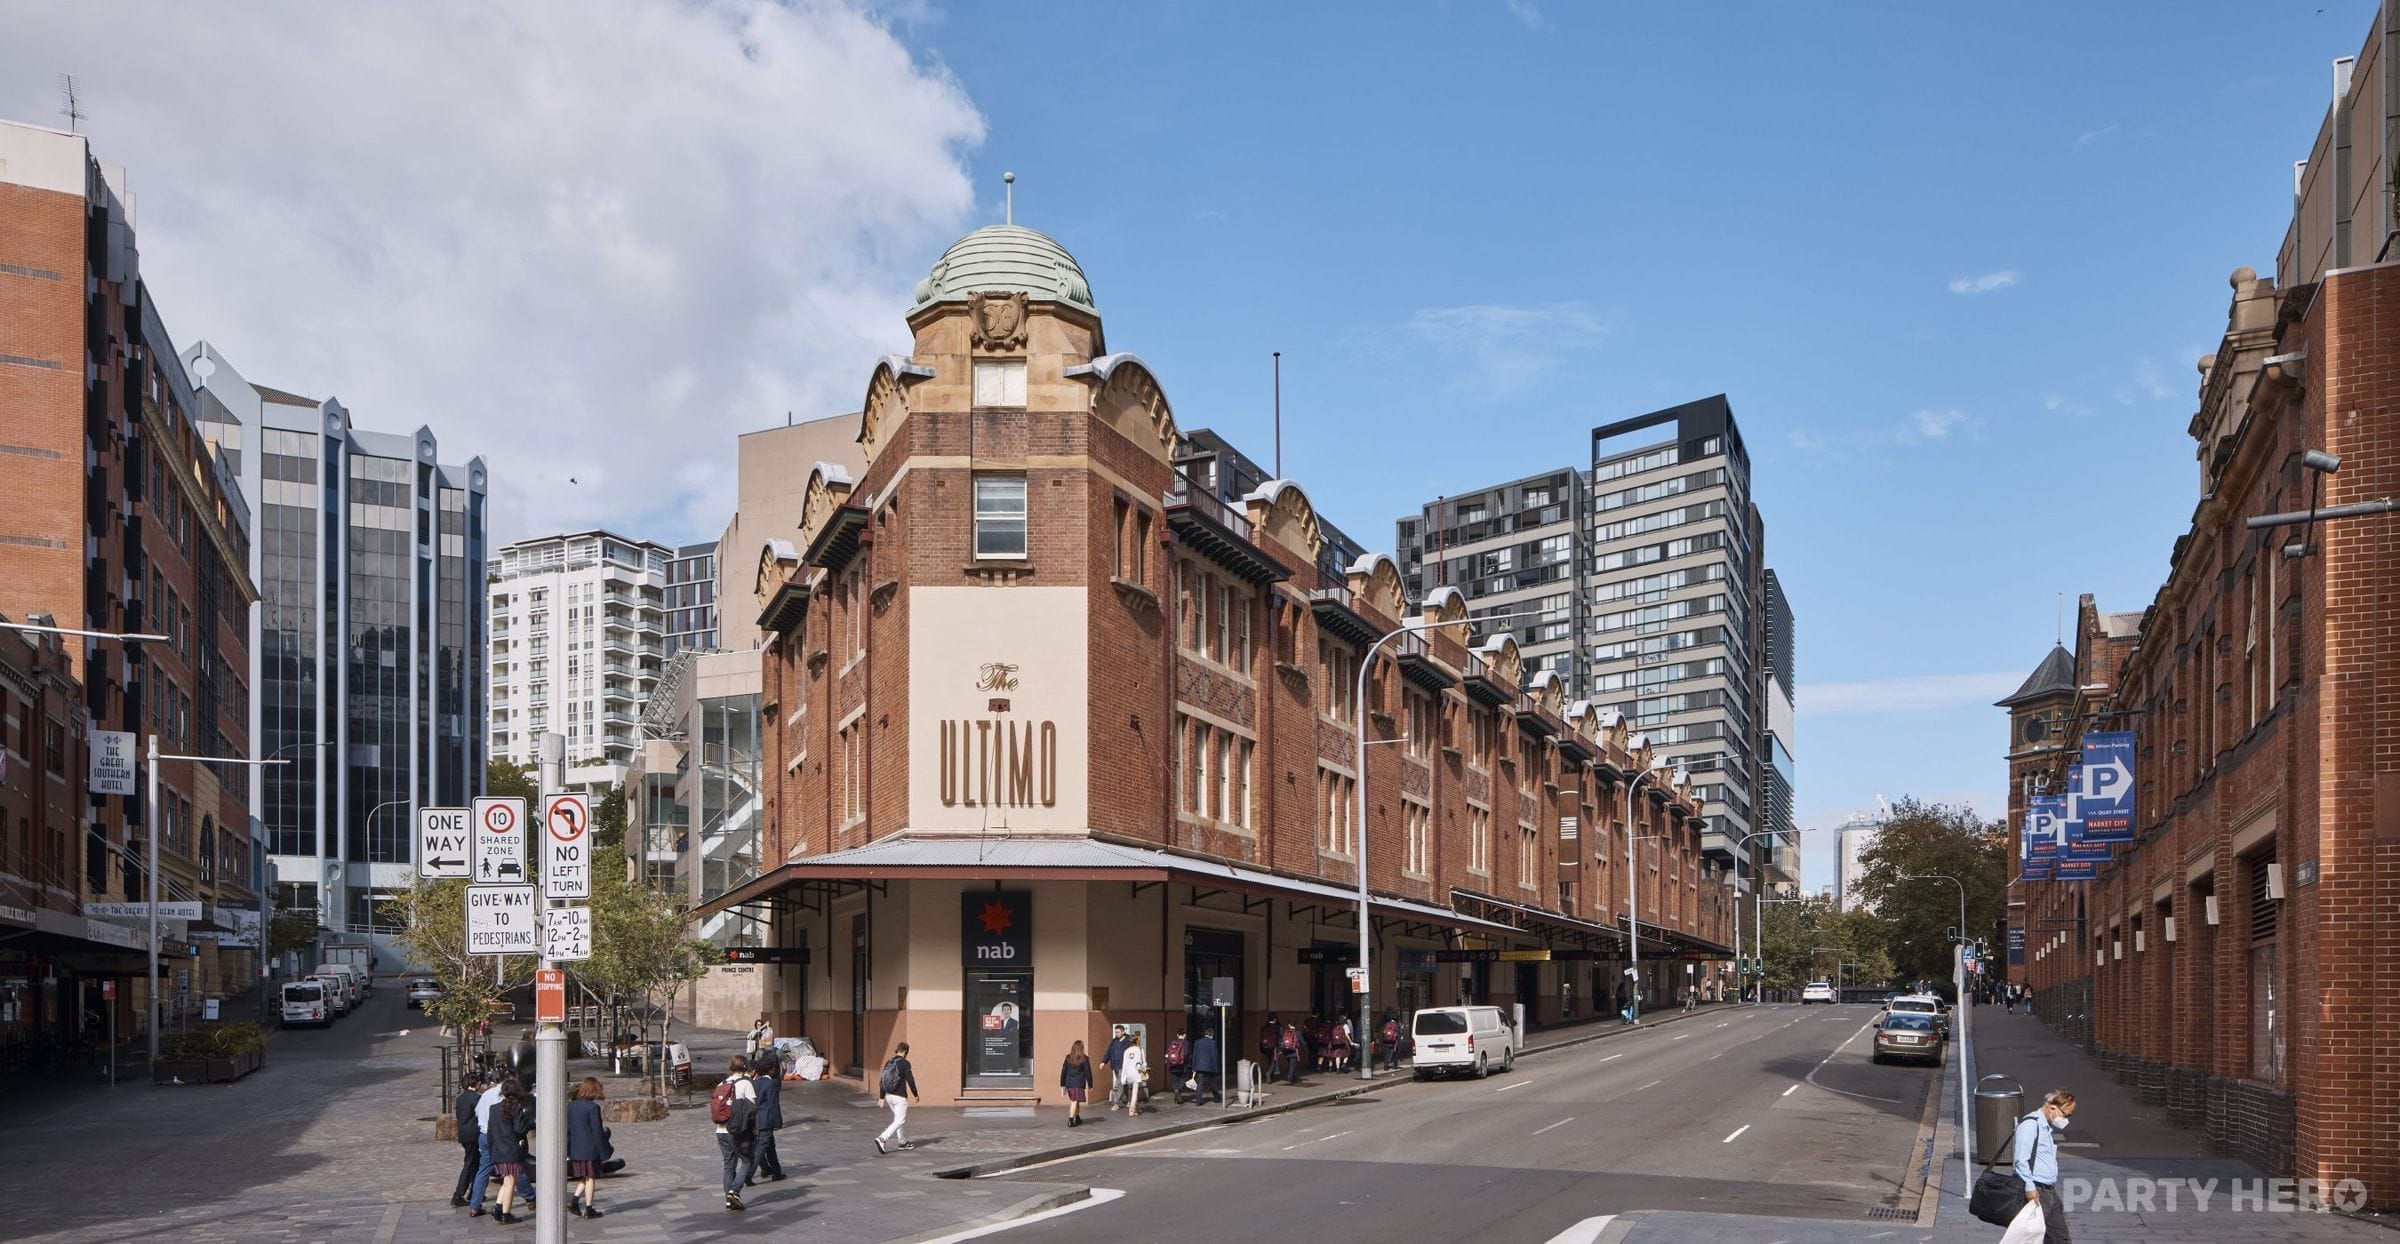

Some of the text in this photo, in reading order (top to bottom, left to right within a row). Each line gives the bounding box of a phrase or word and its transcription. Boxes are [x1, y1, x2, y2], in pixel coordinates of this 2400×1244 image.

[976, 663, 1019, 692] The
[106, 746, 120, 756] THE
[100, 757, 124, 768] GREAT
[940, 719, 1057, 809] ULTIMO
[94, 768, 130, 780] SOUTHERN
[101, 780, 124, 790] HOTEL
[2092, 768, 2119, 796] P
[428, 815, 463, 830] ONE
[493, 812, 507, 826] 10
[2036, 816, 2052, 832] P
[426, 836, 466, 851] WAY
[480, 836, 520, 844] SHARED
[487, 847, 513, 855] ZONE
[556, 846, 578, 861] NO
[552, 865, 580, 877] LEFT
[552, 882, 582, 892] TURN
[472, 893, 530, 907] GIVE WAY
[495, 912, 509, 926] TO
[473, 931, 531, 946] PEDESTRIANS
[976, 942, 1014, 958] nab
[544, 973, 556, 982] NO
